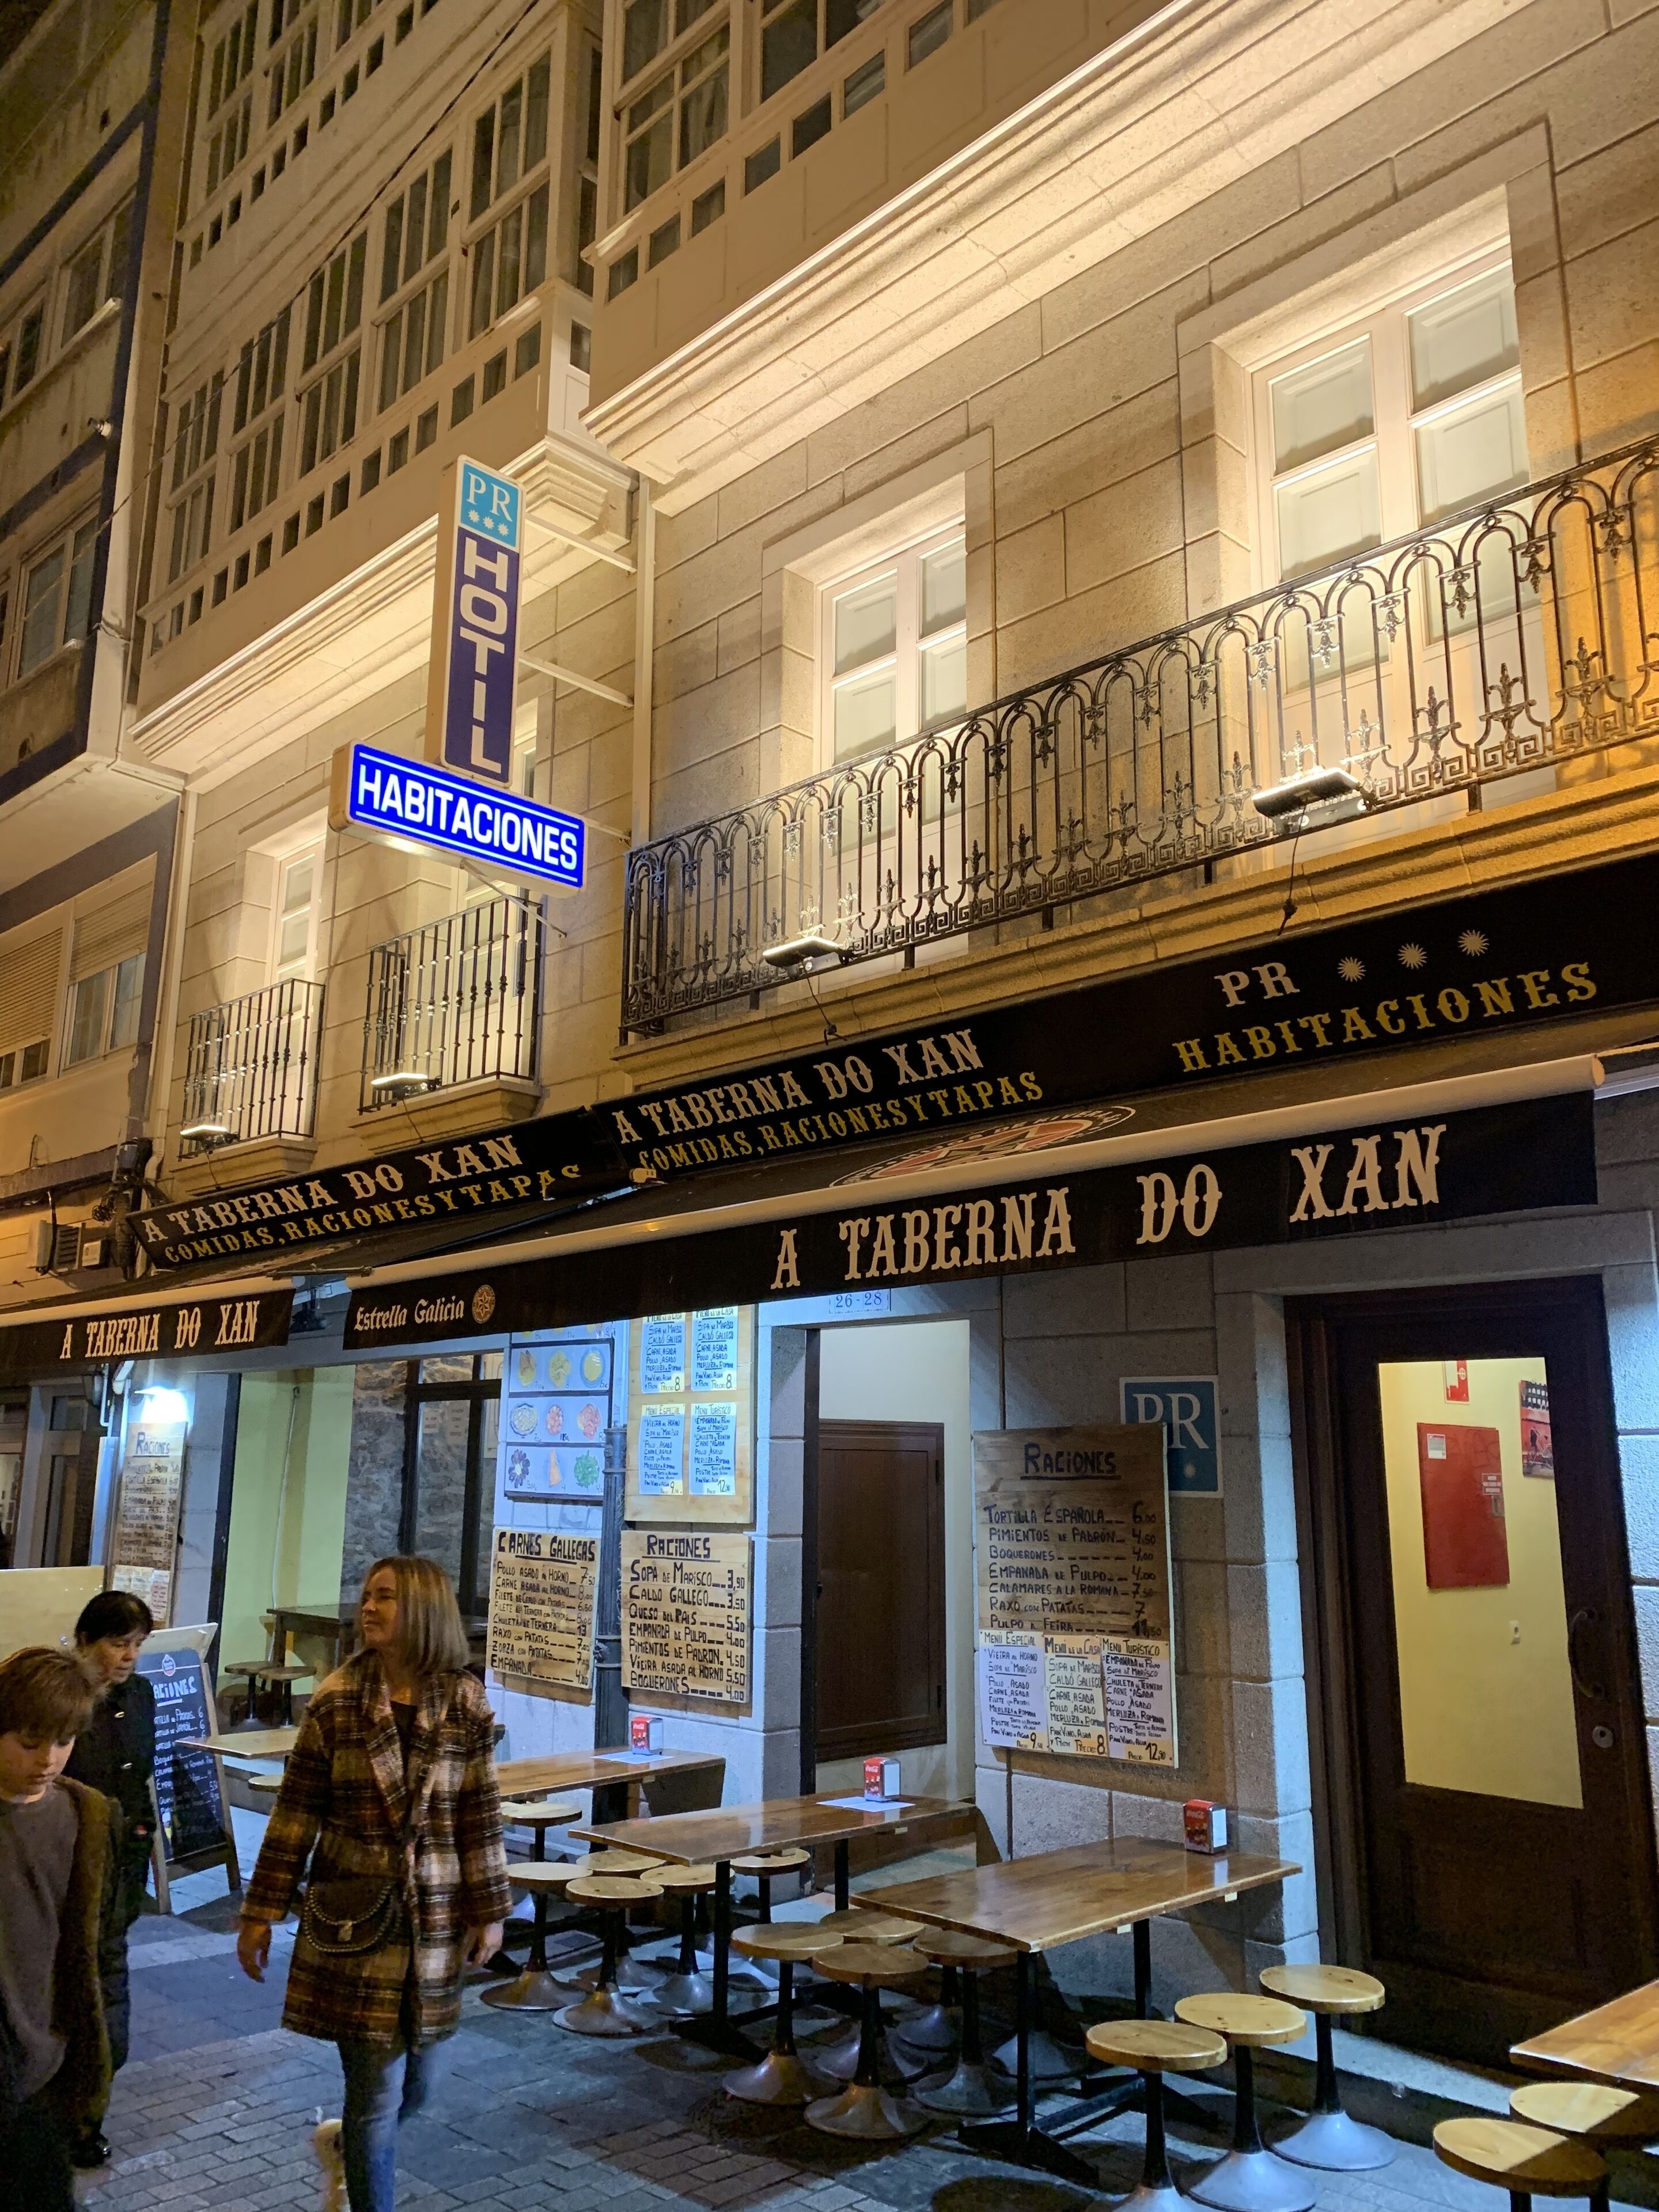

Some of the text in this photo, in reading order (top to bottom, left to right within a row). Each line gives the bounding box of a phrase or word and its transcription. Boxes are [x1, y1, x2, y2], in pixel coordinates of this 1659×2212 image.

[467, 472, 512, 522] PR
[459, 536, 510, 774] HOTIL
[358, 763, 577, 870] HABITACIONES
[1214, 961, 1300, 1007] PR
[1172, 961, 1598, 1073] HABITACIONES
[612, 1029, 983, 1144] A TABERNA DO XAN
[758, 1099, 908, 1150] RACIONES
[904, 1094, 928, 1121] Y
[926, 1071, 1043, 1116] TAPAS
[142, 1134, 522, 1243] A TABERNA DO XAN
[283, 1195, 435, 1241] RACIONES
[434, 1190, 459, 1210] Y
[771, 1124, 1446, 1290] A TABERNA DO XAN
[354, 1305, 407, 1331] Estrella
[415, 1296, 464, 1324] Galicia
[60, 1301, 260, 1359] A TABERNA DO XAN
[498, 1532, 595, 1562] CARNES GALLEGAS
[990, 1545, 1055, 1561] BOQUERONES
[497, 1561, 515, 1576] POLLO
[520, 1567, 539, 1580] ASADO
[549, 1569, 569, 1584] HORNO
[631, 1559, 657, 1582] SOPA
[662, 1572, 670, 1582] DE
[990, 1562, 1048, 1580] EMPANADA
[1070, 1565, 1107, 1581] PULPO
[496, 1577, 517, 1590] CARNE
[521, 1581, 540, 1593] ASADA
[550, 1585, 569, 1598] HORNO
[630, 1585, 662, 1601] CALDO
[670, 1586, 709, 1606] GALLEGO
[990, 1583, 1052, 1594] CALAMARES
[1056, 1585, 1062, 1594] A
[1066, 1585, 1076, 1594] LA
[1081, 1584, 1118, 1596] ROMANA
[630, 1603, 658, 1622] QUESO
[663, 1611, 673, 1622] DEL
[990, 1597, 1145, 1618] RAXO CON PATATAS 7
[531, 1618, 556, 1632] TERNERA
[577, 1624, 586, 1637] 13
[630, 1622, 670, 1639] EMPANADA
[675, 1630, 681, 1641] DE
[685, 1627, 706, 1642] PULPO
[990, 1614, 1024, 1628] PULPO
[493, 1626, 512, 1639] RAXO
[525, 1631, 549, 1645] PATATAS
[493, 1641, 514, 1654] ZORZA
[529, 1645, 552, 1660] PATATAS
[675, 1647, 683, 1658] DE
[491, 1654, 532, 1676] EMPANADA
[662, 1661, 685, 1675] ASADA
[688, 1666, 696, 1677] AL
[699, 1665, 723, 1681] HORNO
[150, 1676, 198, 1699] ACIONES
[631, 1671, 690, 1694] BOQUERONES
[1049, 1689, 1070, 1700] CARNE
[1050, 1701, 1096, 1715] POLLO ASADO
[1097, 1734, 1105, 1755] 8
